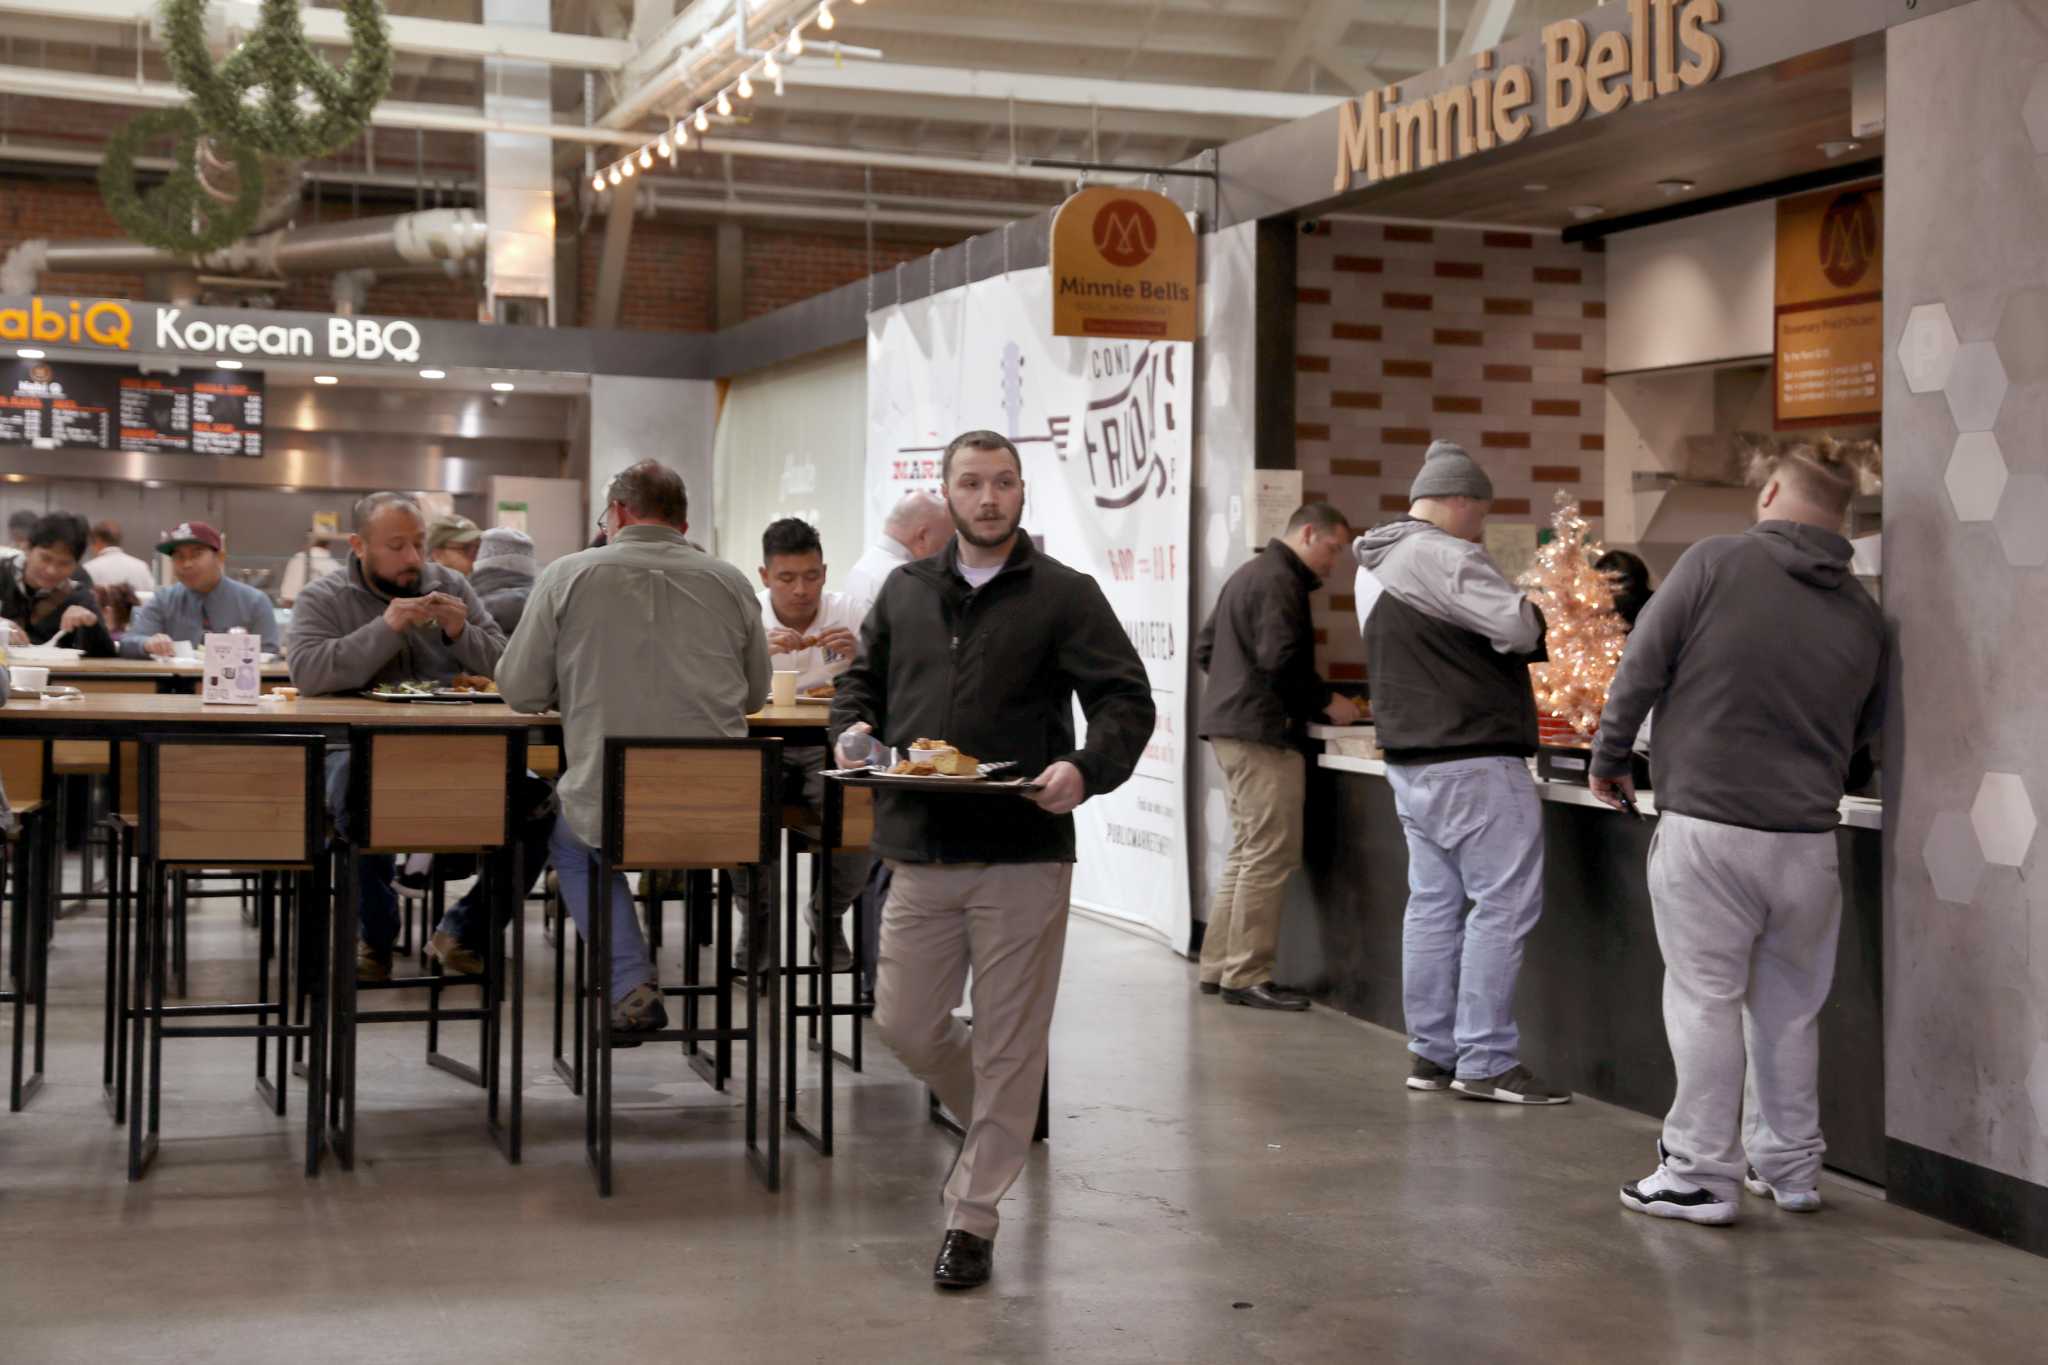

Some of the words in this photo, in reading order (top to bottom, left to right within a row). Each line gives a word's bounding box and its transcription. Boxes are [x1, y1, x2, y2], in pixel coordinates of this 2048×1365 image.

[1334, 49, 1532, 192] Minnie
[1060, 276, 1135, 298] Minnie
[155, 307, 313, 357] Korean
[327, 317, 421, 363] BBQ
